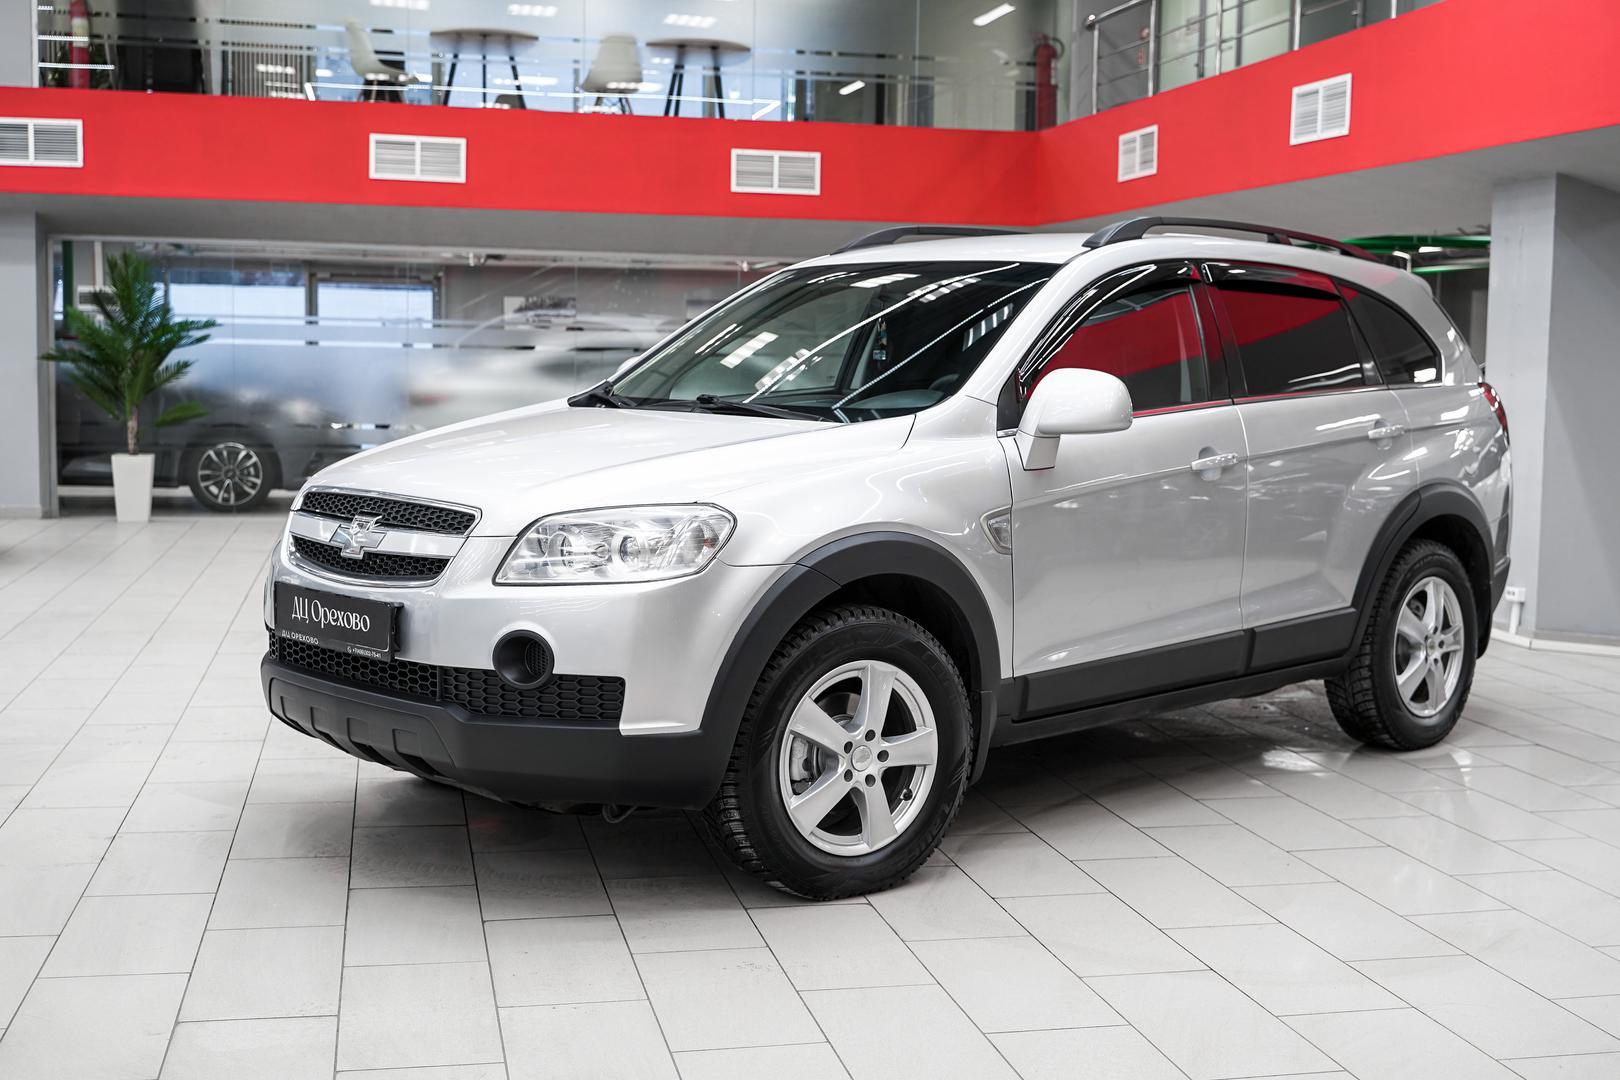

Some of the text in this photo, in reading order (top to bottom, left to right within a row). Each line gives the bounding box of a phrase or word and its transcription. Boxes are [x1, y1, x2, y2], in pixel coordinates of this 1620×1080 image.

[292, 596, 370, 632] ДЦ Орехово
[291, 631, 319, 645] ОРЕХОВО
